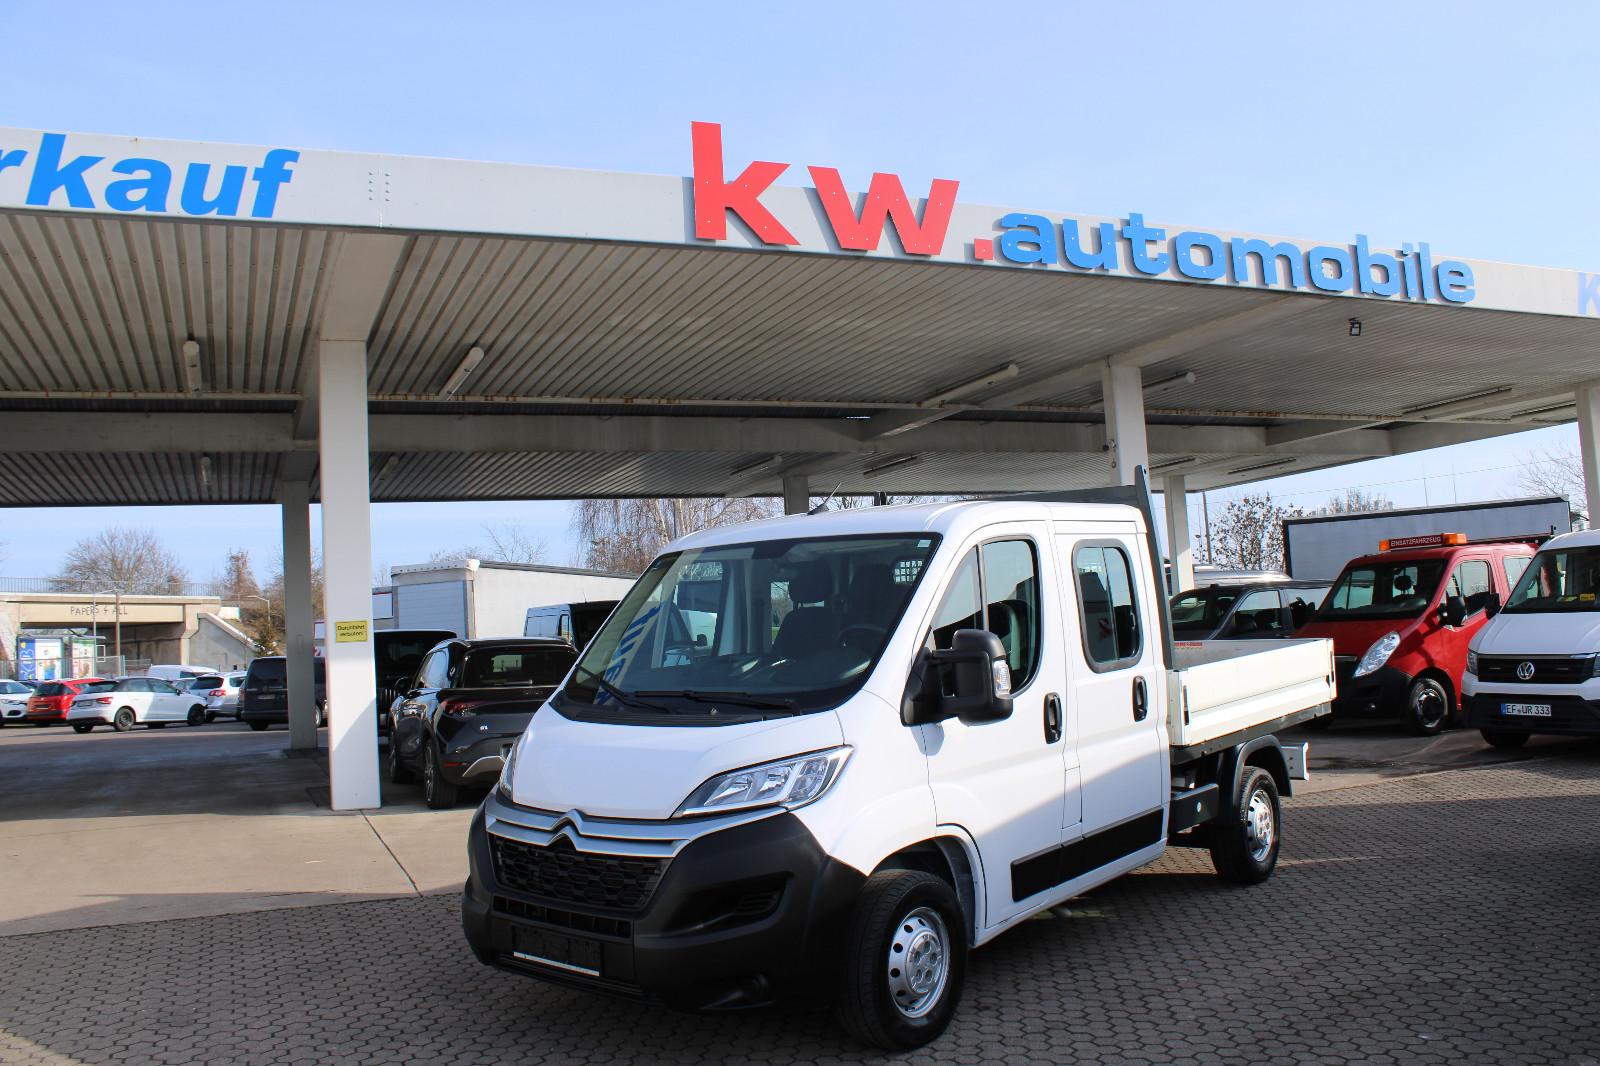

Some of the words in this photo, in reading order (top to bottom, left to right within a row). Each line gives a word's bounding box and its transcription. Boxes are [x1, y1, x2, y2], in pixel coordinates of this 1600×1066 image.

[1390, 536, 1441, 547] EINSATZFAHRZEUG
[1506, 704, 1516, 714] EF
[1521, 705, 1533, 715] UR
[1534, 705, 1550, 716] 333
